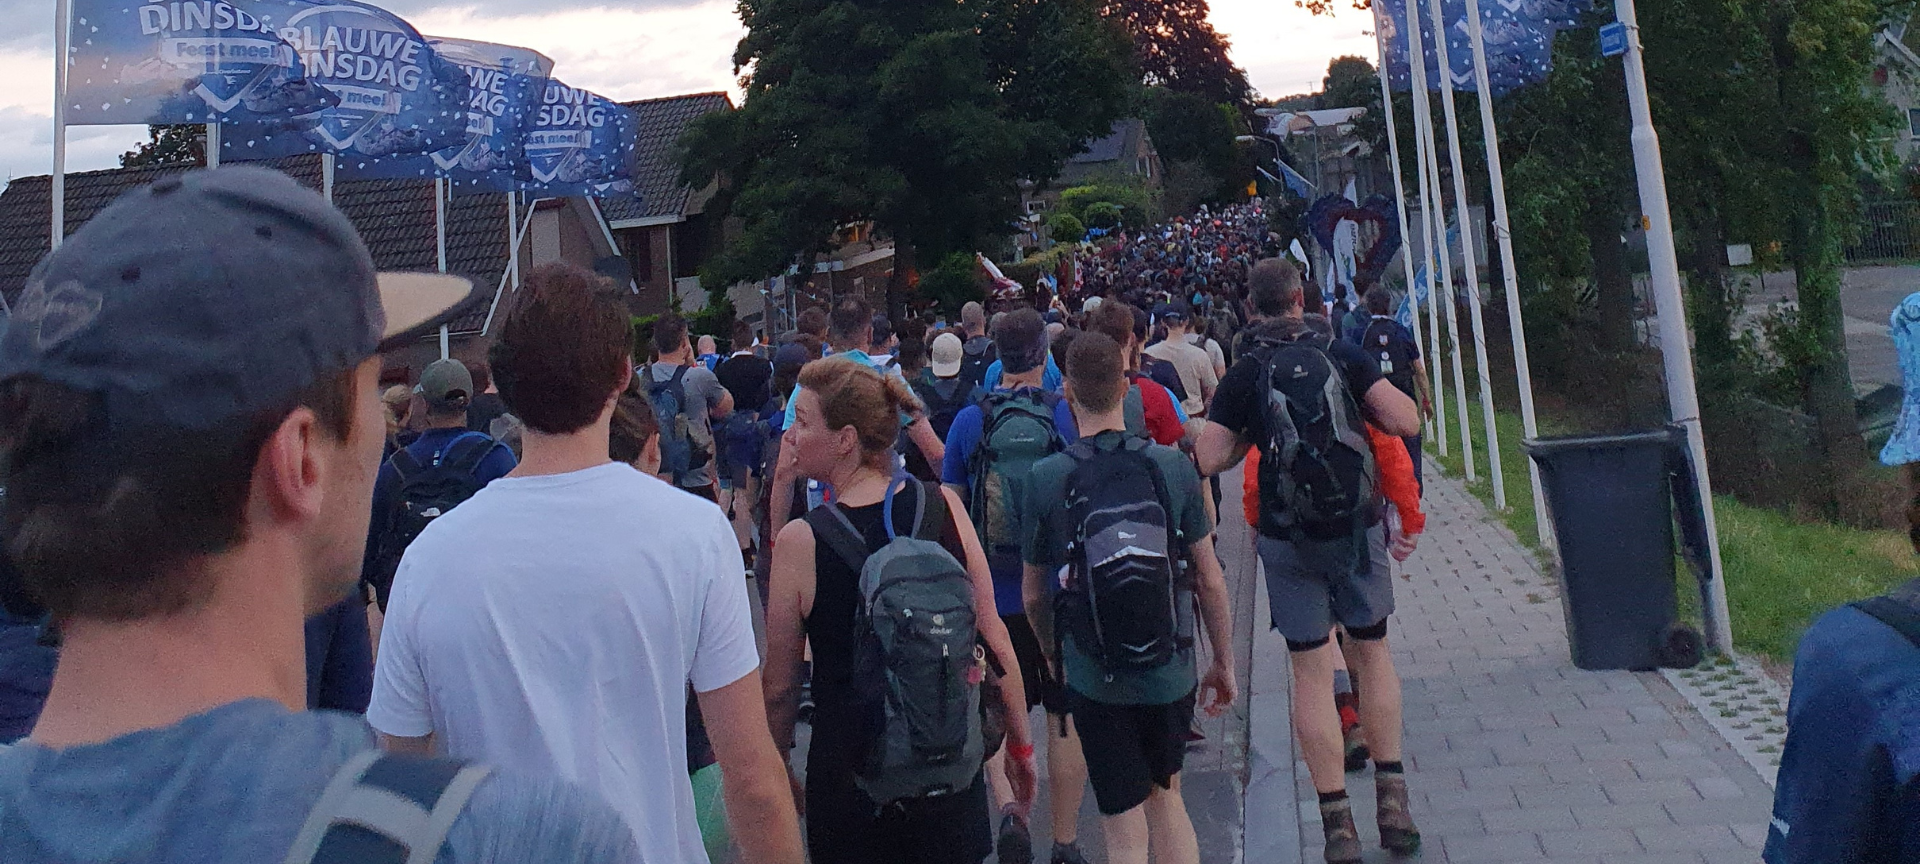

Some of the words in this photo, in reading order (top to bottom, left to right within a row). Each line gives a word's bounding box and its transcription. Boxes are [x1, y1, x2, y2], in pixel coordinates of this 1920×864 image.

[280, 26, 422, 64] BLAUWE
[300, 52, 422, 91] INSDAG
[469, 90, 508, 117] AG
